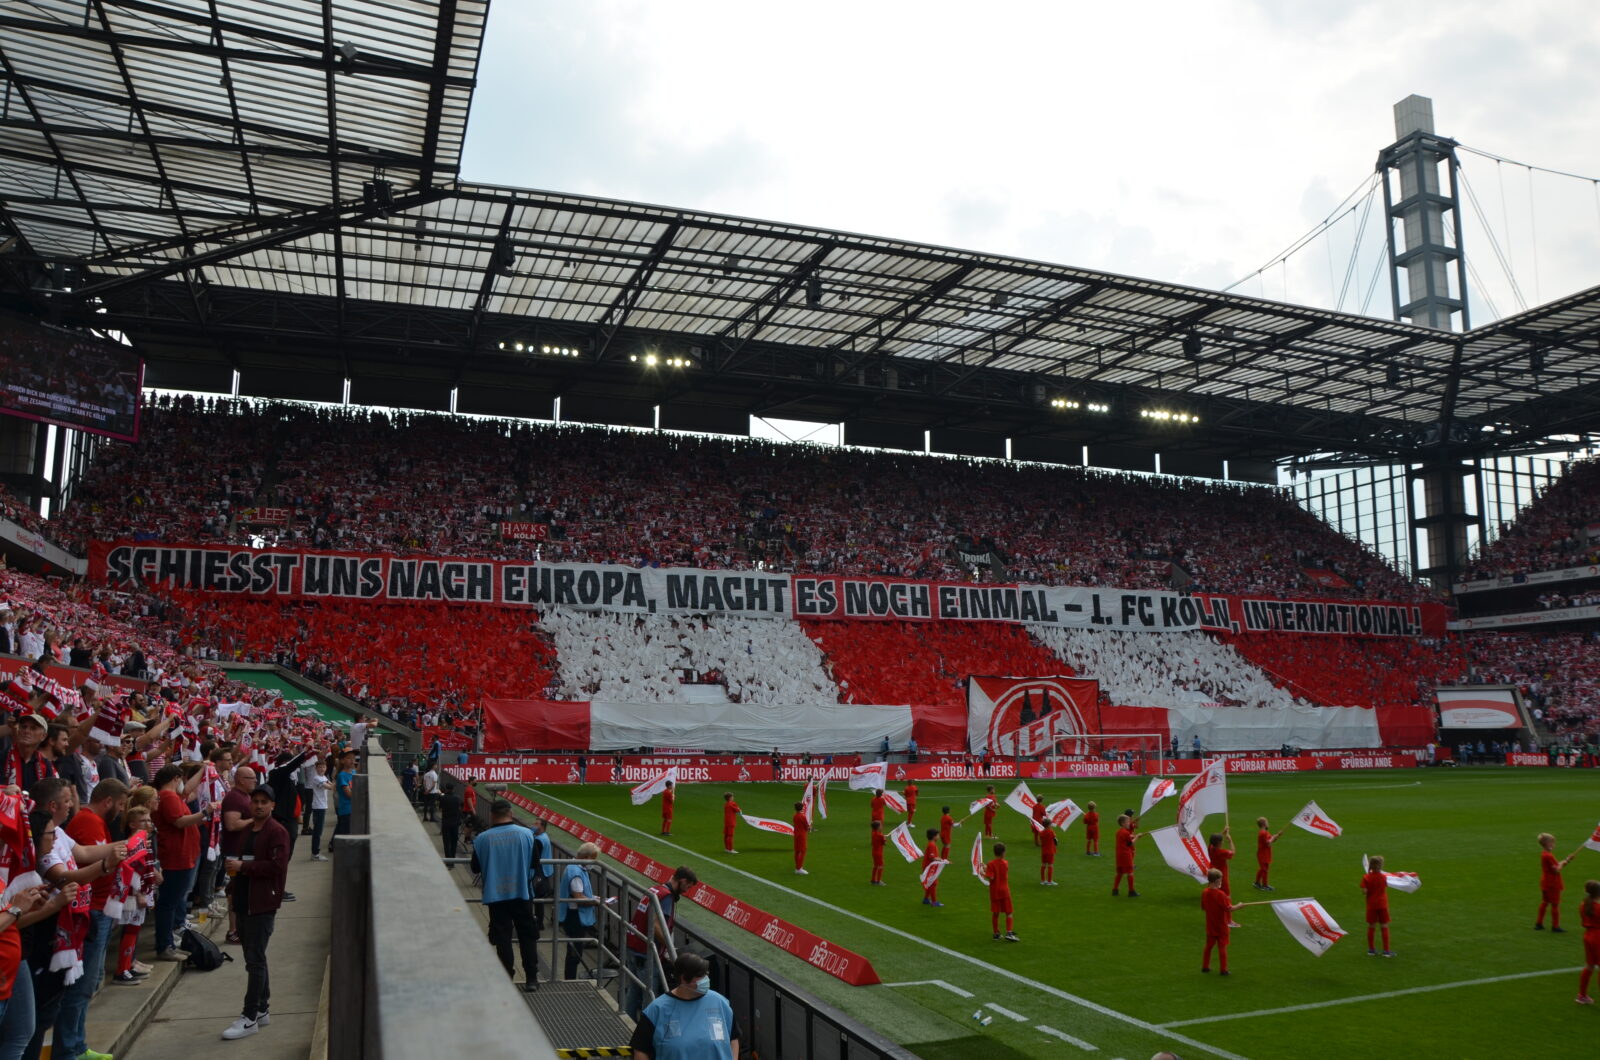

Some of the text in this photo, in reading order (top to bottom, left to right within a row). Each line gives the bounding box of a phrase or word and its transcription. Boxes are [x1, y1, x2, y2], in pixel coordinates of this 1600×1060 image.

[502, 522, 547, 537] HAWKS
[513, 532, 536, 540] KÖLN
[958, 550, 991, 565] TROIKA
[107, 546, 303, 594] SCHIESST
[303, 556, 385, 599] UNS
[387, 558, 495, 603] NACH
[503, 565, 656, 613] EUROPA,
[667, 574, 788, 613] MACHT
[796, 578, 839, 615] ES
[843, 580, 932, 618] NOCH
[939, 584, 1060, 623] EINMAL
[1091, 593, 1112, 625] 1.
[1121, 595, 1154, 627] FC
[1160, 590, 1240, 634] KÖLN,
[1241, 598, 1424, 635] INTERNATIONAL!
[1231, 759, 1298, 772] SPÜRBAR ANDERS.
[1341, 757, 1373, 769] SPÜRBAR
[693, 886, 716, 908] DERTOUR
[723, 901, 751, 927] DERTOUR
[761, 920, 795, 950] DERTOUR
[808, 942, 849, 977] DERTOUR
